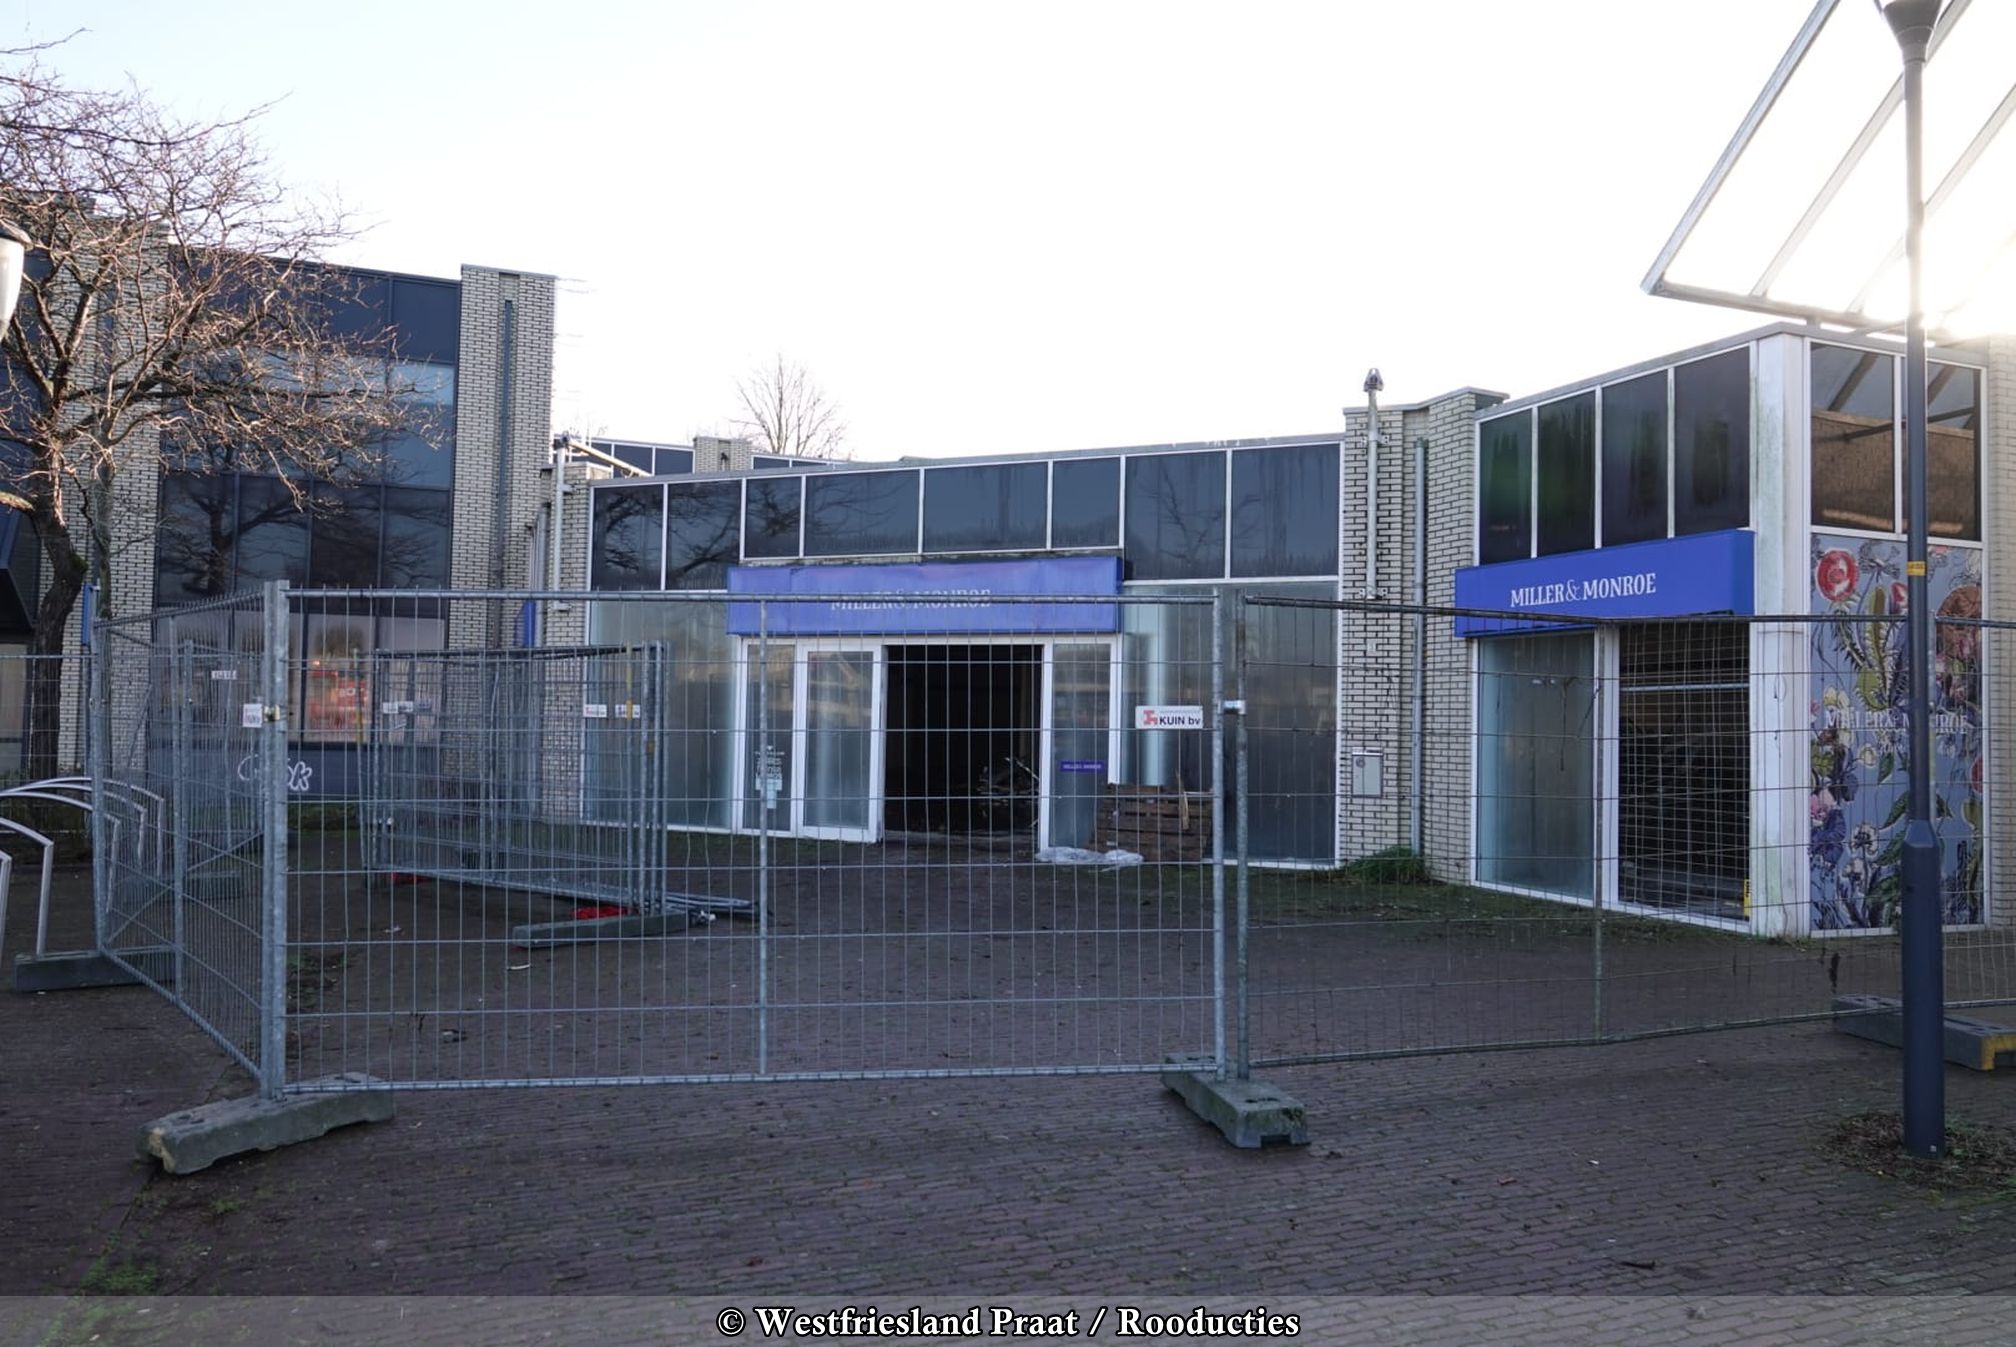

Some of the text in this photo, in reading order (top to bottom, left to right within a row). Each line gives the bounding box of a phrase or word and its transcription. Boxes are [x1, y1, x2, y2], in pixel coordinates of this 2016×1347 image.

[1582, 573, 1657, 600] MONROE
[1159, 715, 1201, 726] KUIN bv
